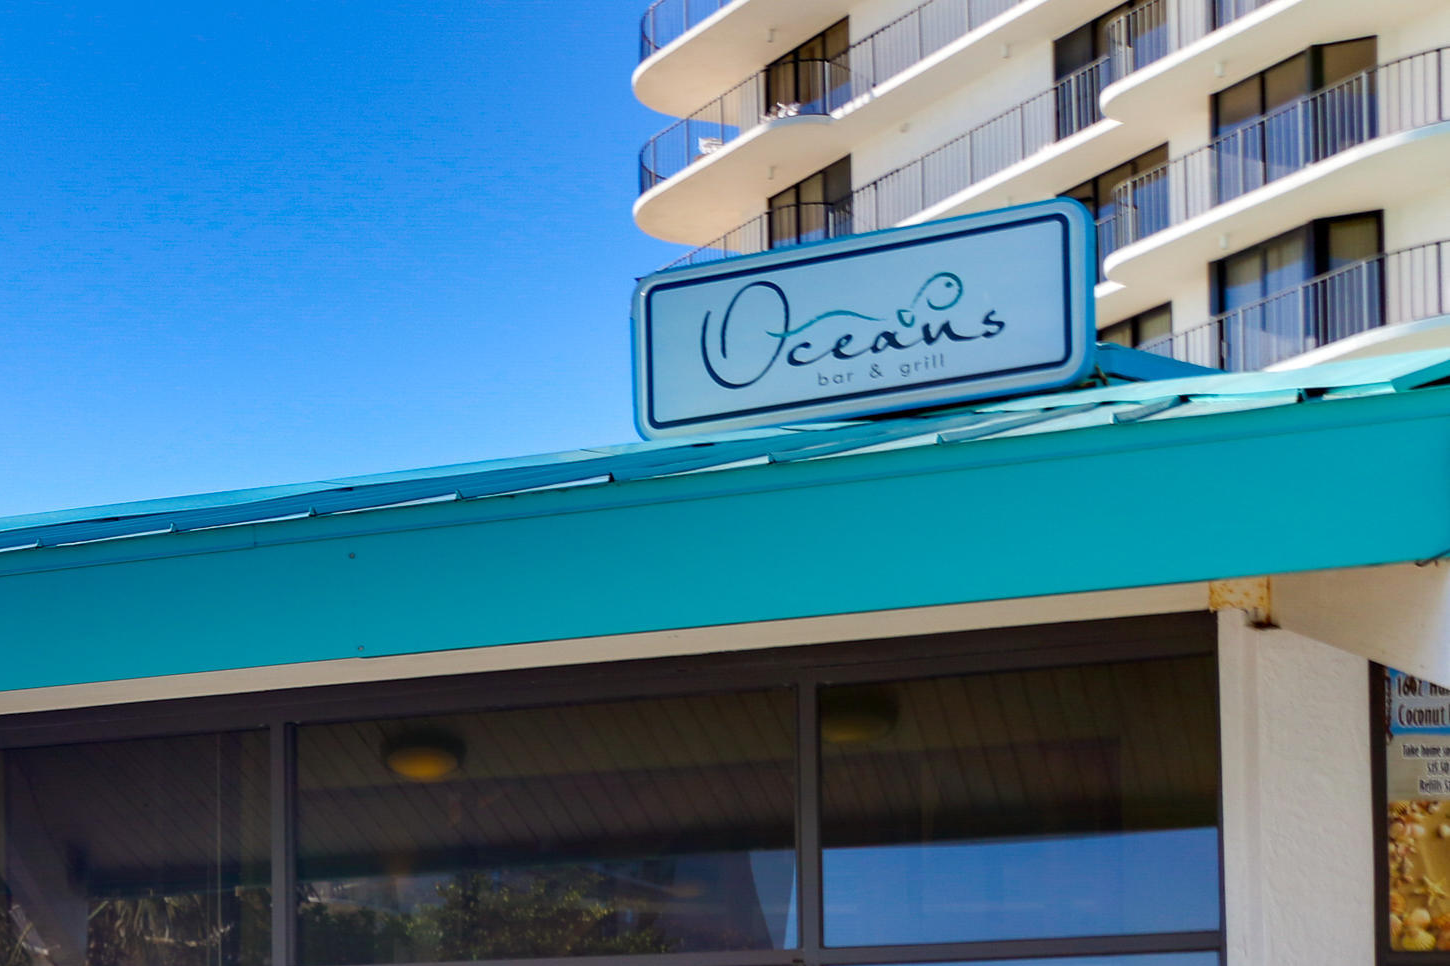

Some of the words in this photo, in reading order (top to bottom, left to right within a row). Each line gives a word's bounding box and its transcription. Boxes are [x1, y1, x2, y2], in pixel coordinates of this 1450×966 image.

[817, 368, 855, 387] bar
[869, 362, 885, 379] &
[899, 353, 946, 379] grill
[1397, 703, 1446, 727] Coconut
[1403, 744, 1420, 757] Take
